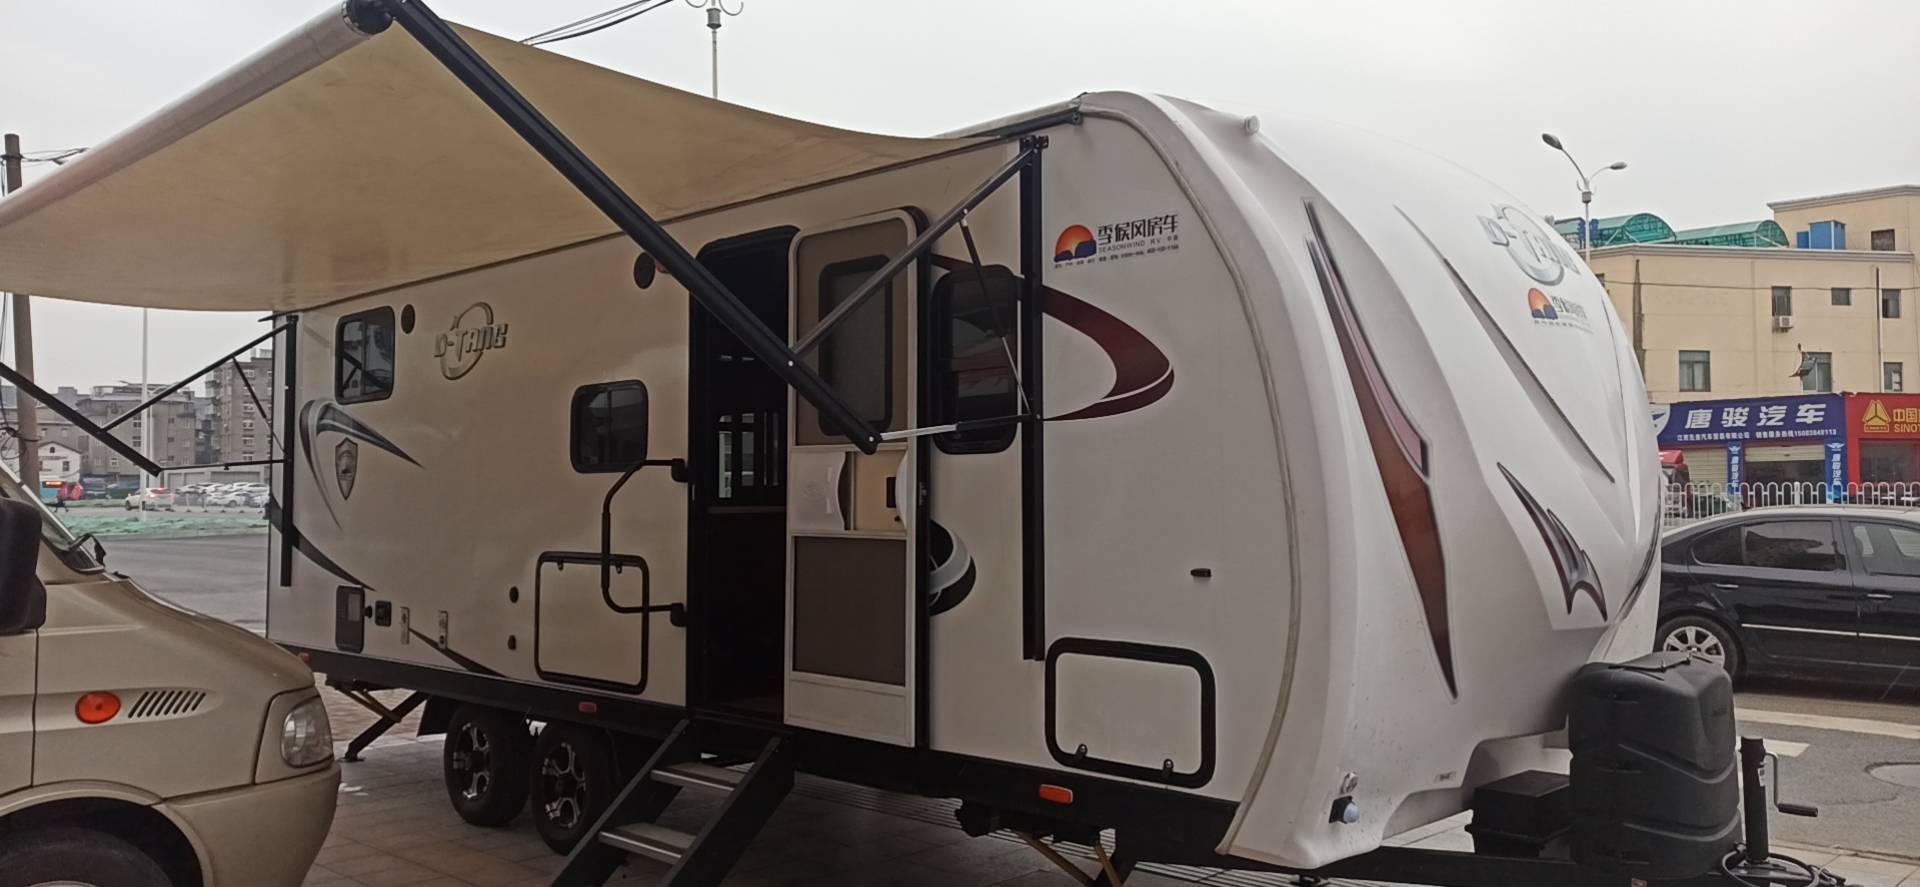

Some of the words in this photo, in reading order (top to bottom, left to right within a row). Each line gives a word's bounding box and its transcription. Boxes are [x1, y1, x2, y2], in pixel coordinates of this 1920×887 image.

[1098, 213, 1178, 246] 季候风房车
[1684, 403, 1827, 429] 唐骏汽车
[1893, 408, 1920, 423] 中国
